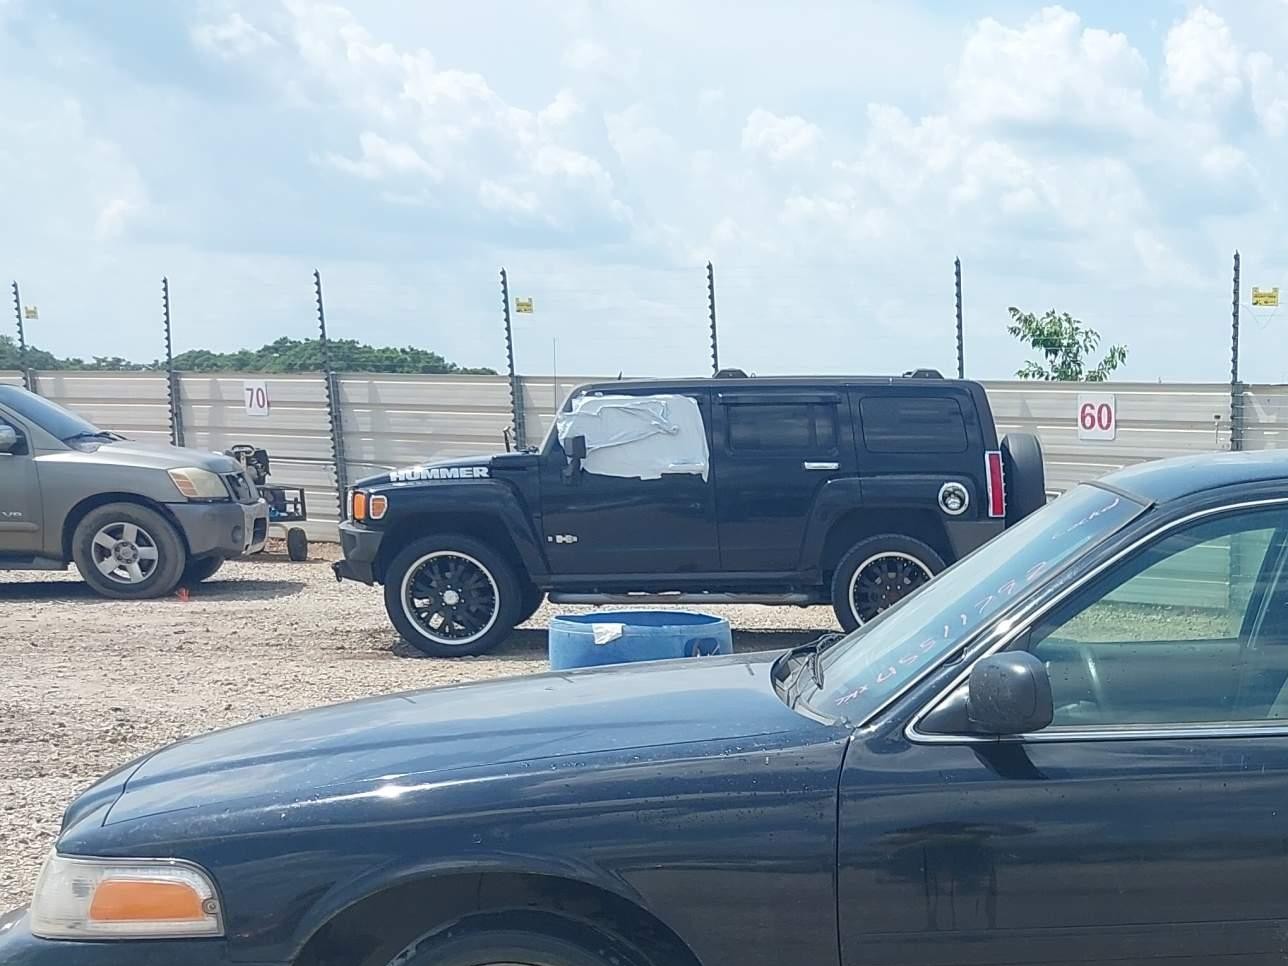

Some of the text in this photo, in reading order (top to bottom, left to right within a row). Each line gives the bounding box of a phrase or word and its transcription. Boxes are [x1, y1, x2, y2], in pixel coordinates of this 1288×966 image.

[245, 387, 266, 408] 70
[1080, 403, 1112, 430] 60
[389, 466, 490, 482] HUMMER
